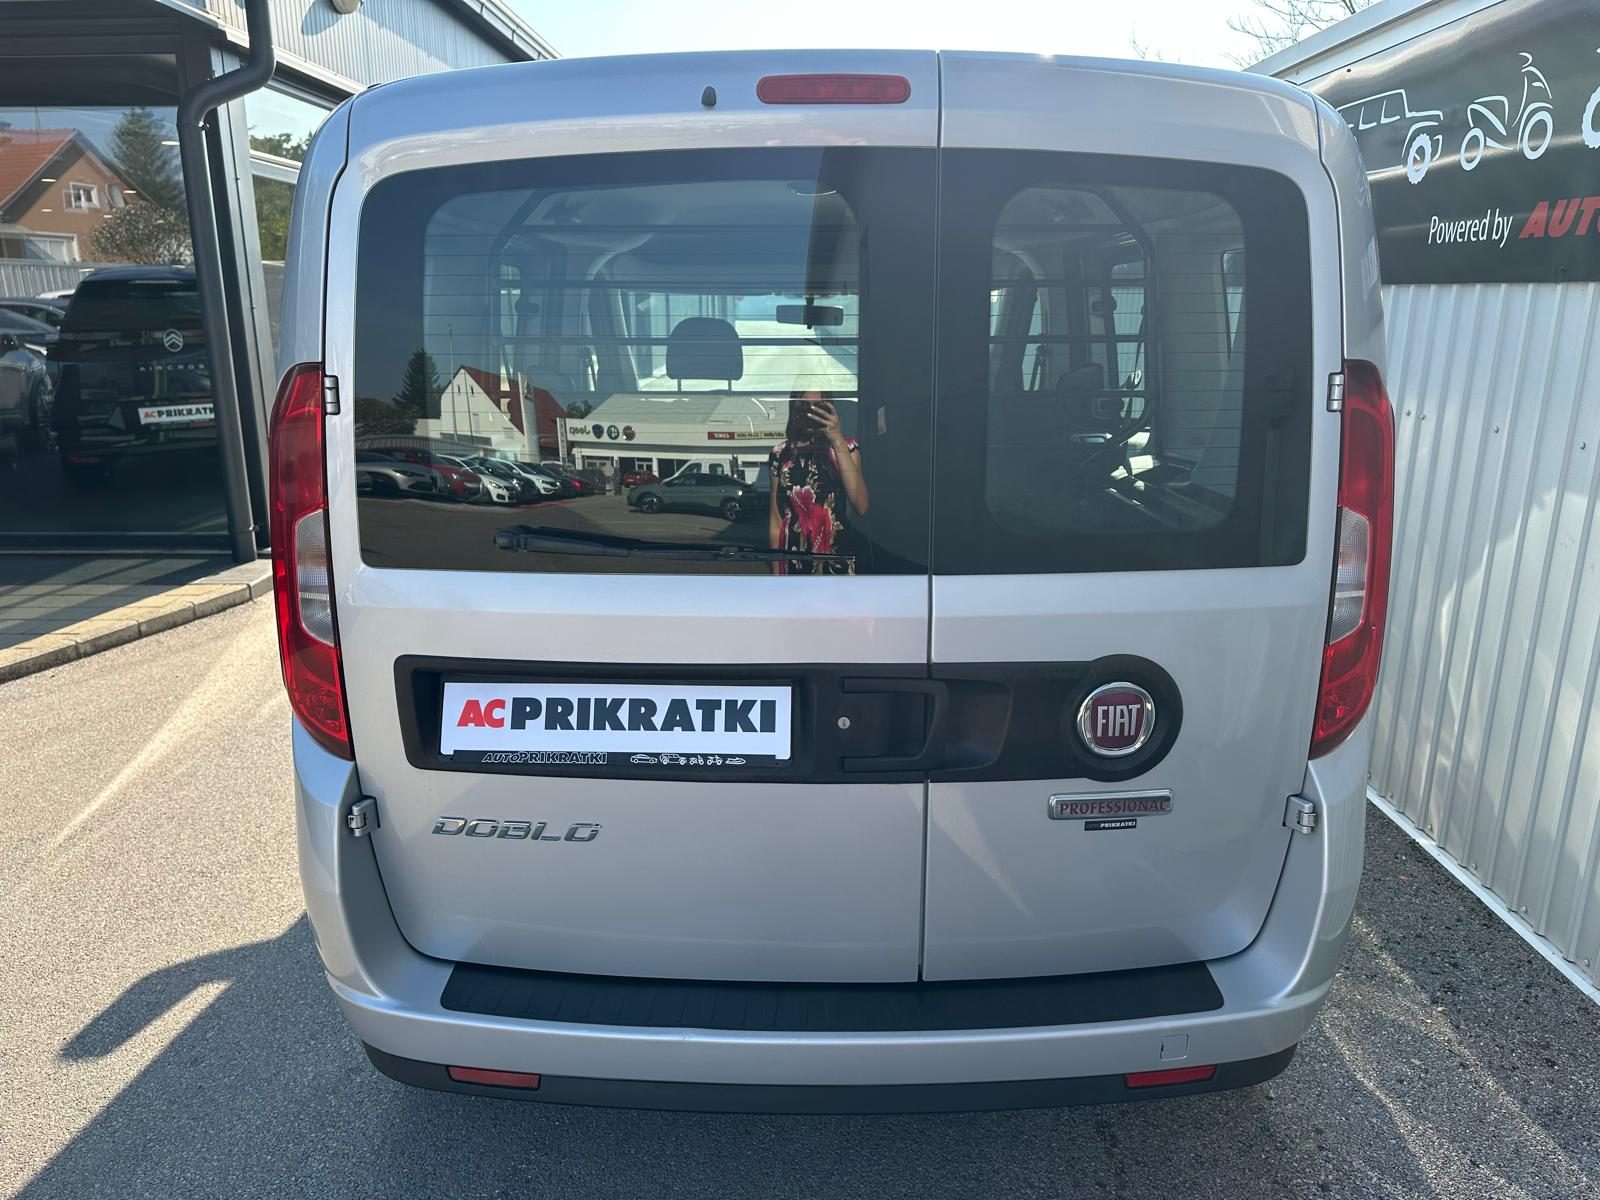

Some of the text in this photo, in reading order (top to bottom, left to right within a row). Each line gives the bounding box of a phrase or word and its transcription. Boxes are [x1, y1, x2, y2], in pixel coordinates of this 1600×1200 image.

[1428, 197, 1600, 248] Powered by AUT
[1096, 704, 1141, 737] FIAT
[1059, 799, 1166, 815] PROFESSIONAL
[431, 816, 602, 843] DOBLO
